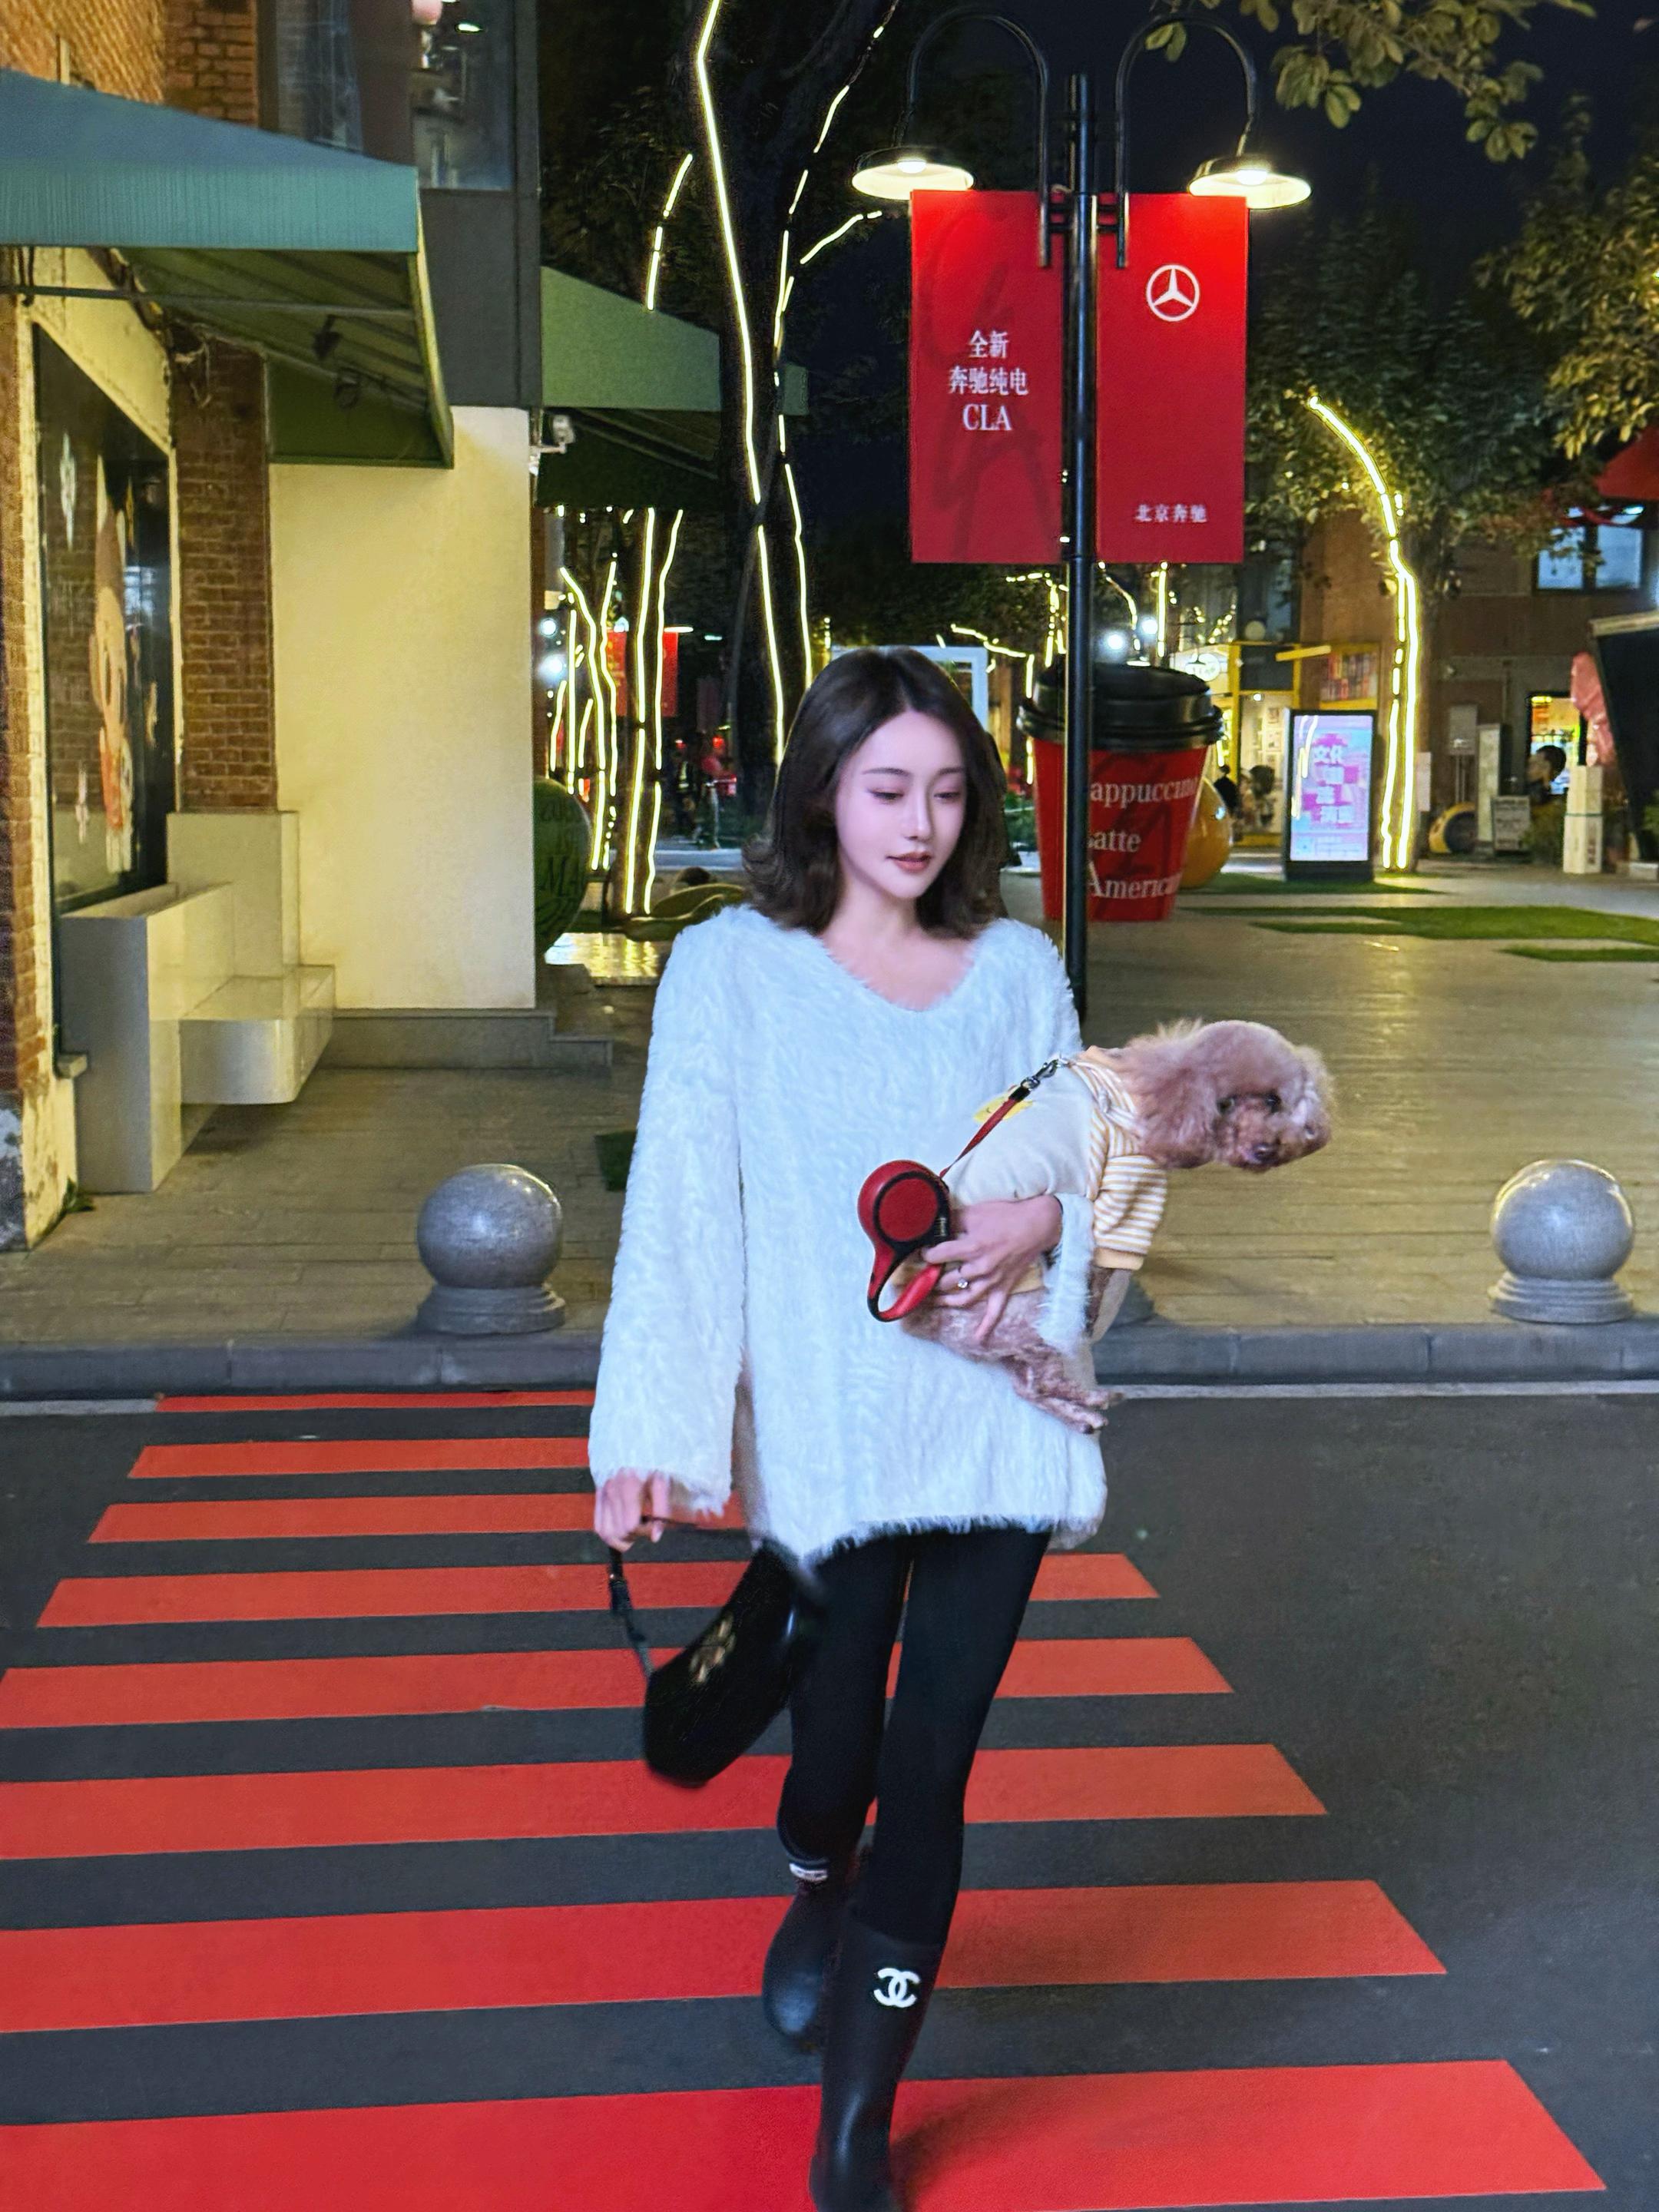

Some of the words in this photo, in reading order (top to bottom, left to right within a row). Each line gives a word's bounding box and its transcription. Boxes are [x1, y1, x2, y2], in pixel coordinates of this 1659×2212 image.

[969, 329, 1009, 359] 全新
[949, 365, 1028, 396] 奔驰纯电
[962, 403, 1012, 431] CLA
[1135, 504, 1207, 523] 北京奔驰
[1088, 830, 1141, 853] atte
